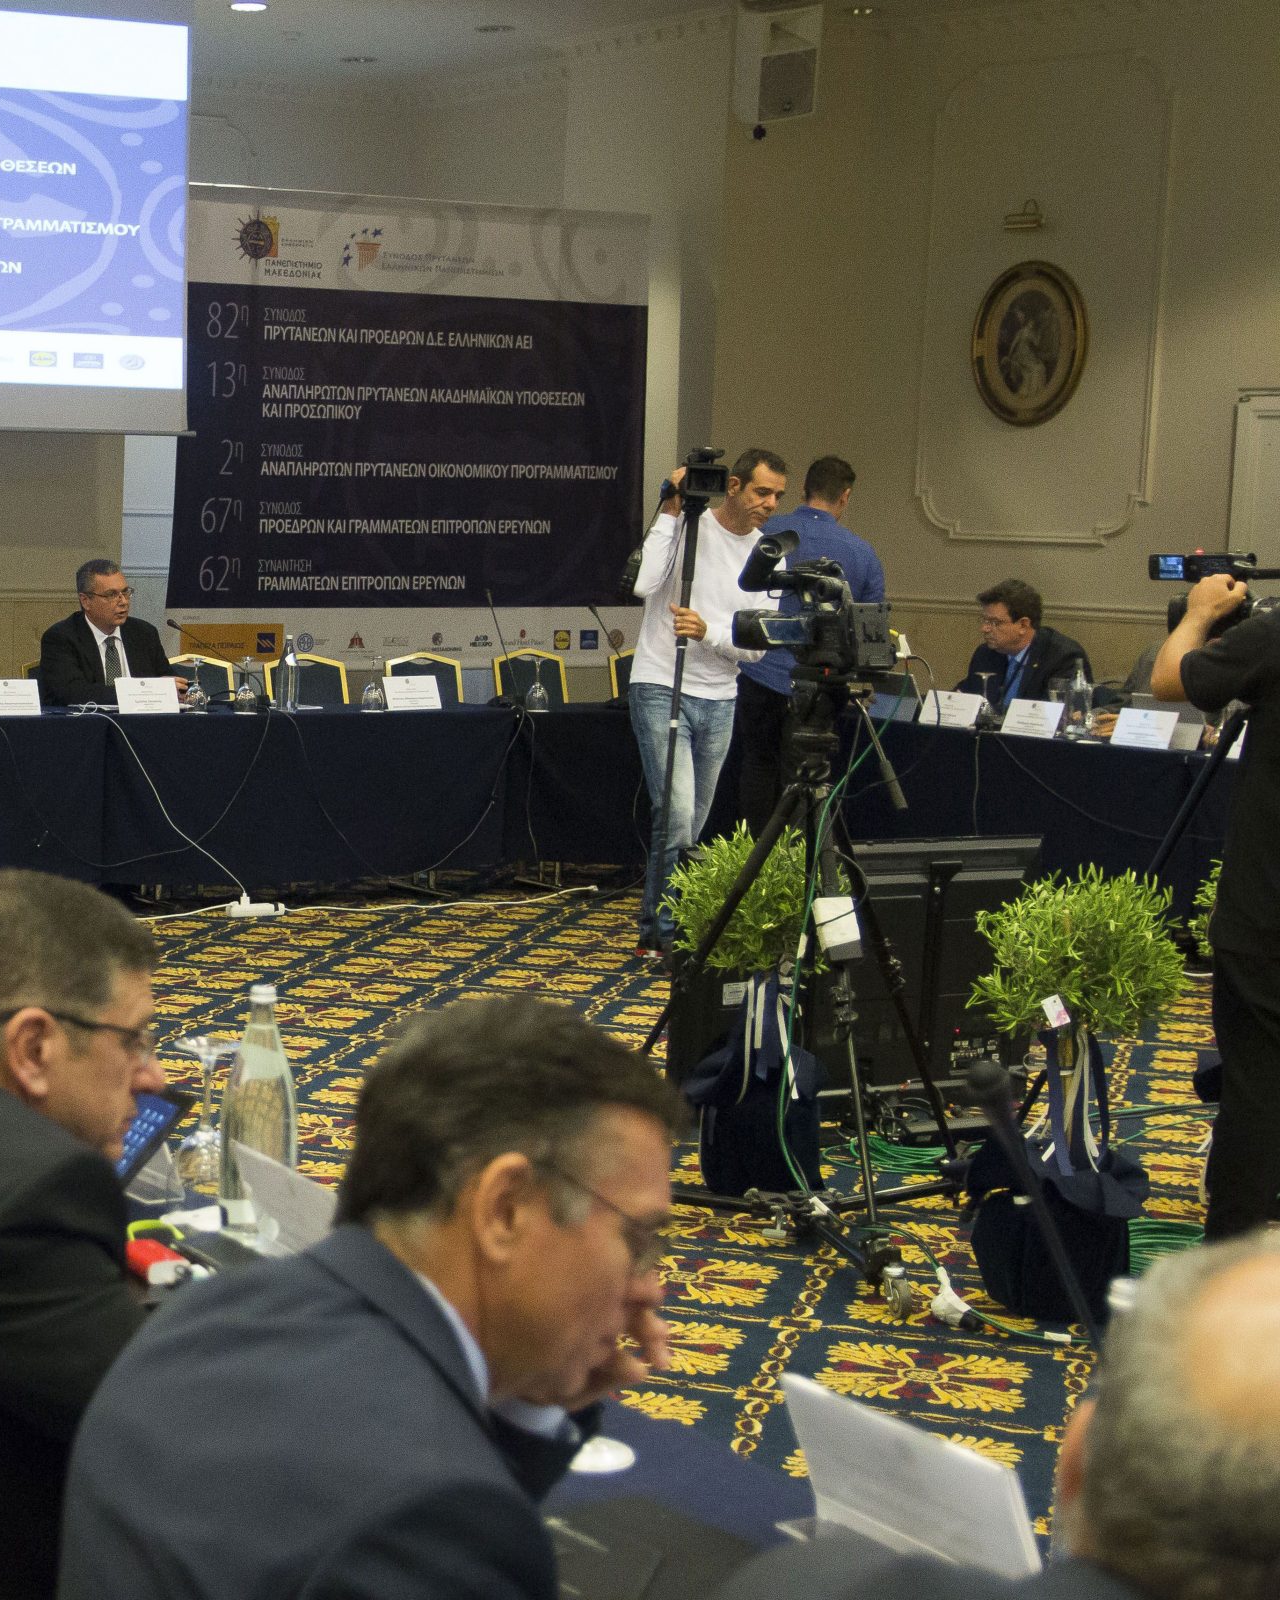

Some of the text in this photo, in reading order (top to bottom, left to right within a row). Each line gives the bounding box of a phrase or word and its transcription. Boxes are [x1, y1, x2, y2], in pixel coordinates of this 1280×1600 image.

[206, 301, 249, 339] 82η
[263, 307, 307, 323] ΣΥΝΟΔΟΣ
[263, 325, 533, 349] ΠΡΥΤΑΝΕΩΝ ΚΑΙ ΠΡΟΕΔΡΩΝ Δ.Ε. ΕΛΛΗΝΙΚΩΝ ΑΕΙ
[207, 361, 247, 398] 13η
[262, 366, 306, 381] ΣΥΝΟΔΟΣ
[262, 384, 355, 401] ΑΝΑΠΛΗΡΩΤΩΝ
[357, 386, 428, 402] ΠΡΥΤΑΝΕΩΝ
[516, 391, 585, 406] ΥΠΟΘΕΣΕΩΝ
[262, 403, 362, 420] ΚΑΙ ΠΡΟΣΩΠΙΚΟΥ
[219, 439, 244, 475] 2η
[260, 443, 304, 457] ΣΥΝΟΔΟΣ
[260, 461, 618, 480] ΑΝΑΠΛΗΡΩΤΩΝ ΠΡΥΤΑΝΕΩΝ ΟΙΚΟΝΟΜΙΚΟΥ ΠΡΟΓΡΑΜΜΑΤΙΣΜΟΥ
[201, 497, 242, 534] 67η
[259, 501, 303, 515] ΣΥΝΟΔΟΣ
[259, 519, 551, 534] ΠΡΟΕΔΡΩΝ ΚΑΙ ΓΡΑΜΜΑΤΕΩΝ ΕΠΙΤΡΟΠΩΝ ΕΡΕΥΝΩΝ
[199, 556, 241, 592] 62η
[258, 559, 312, 573] ΣΥΝΑΝΤΗΣΗ
[257, 575, 466, 591] ΓΡΑΜΜΑΤΕΩΝ ΕΠΙΤΡΟΠΩΝ ΕΡΕΥΝΩΝ
